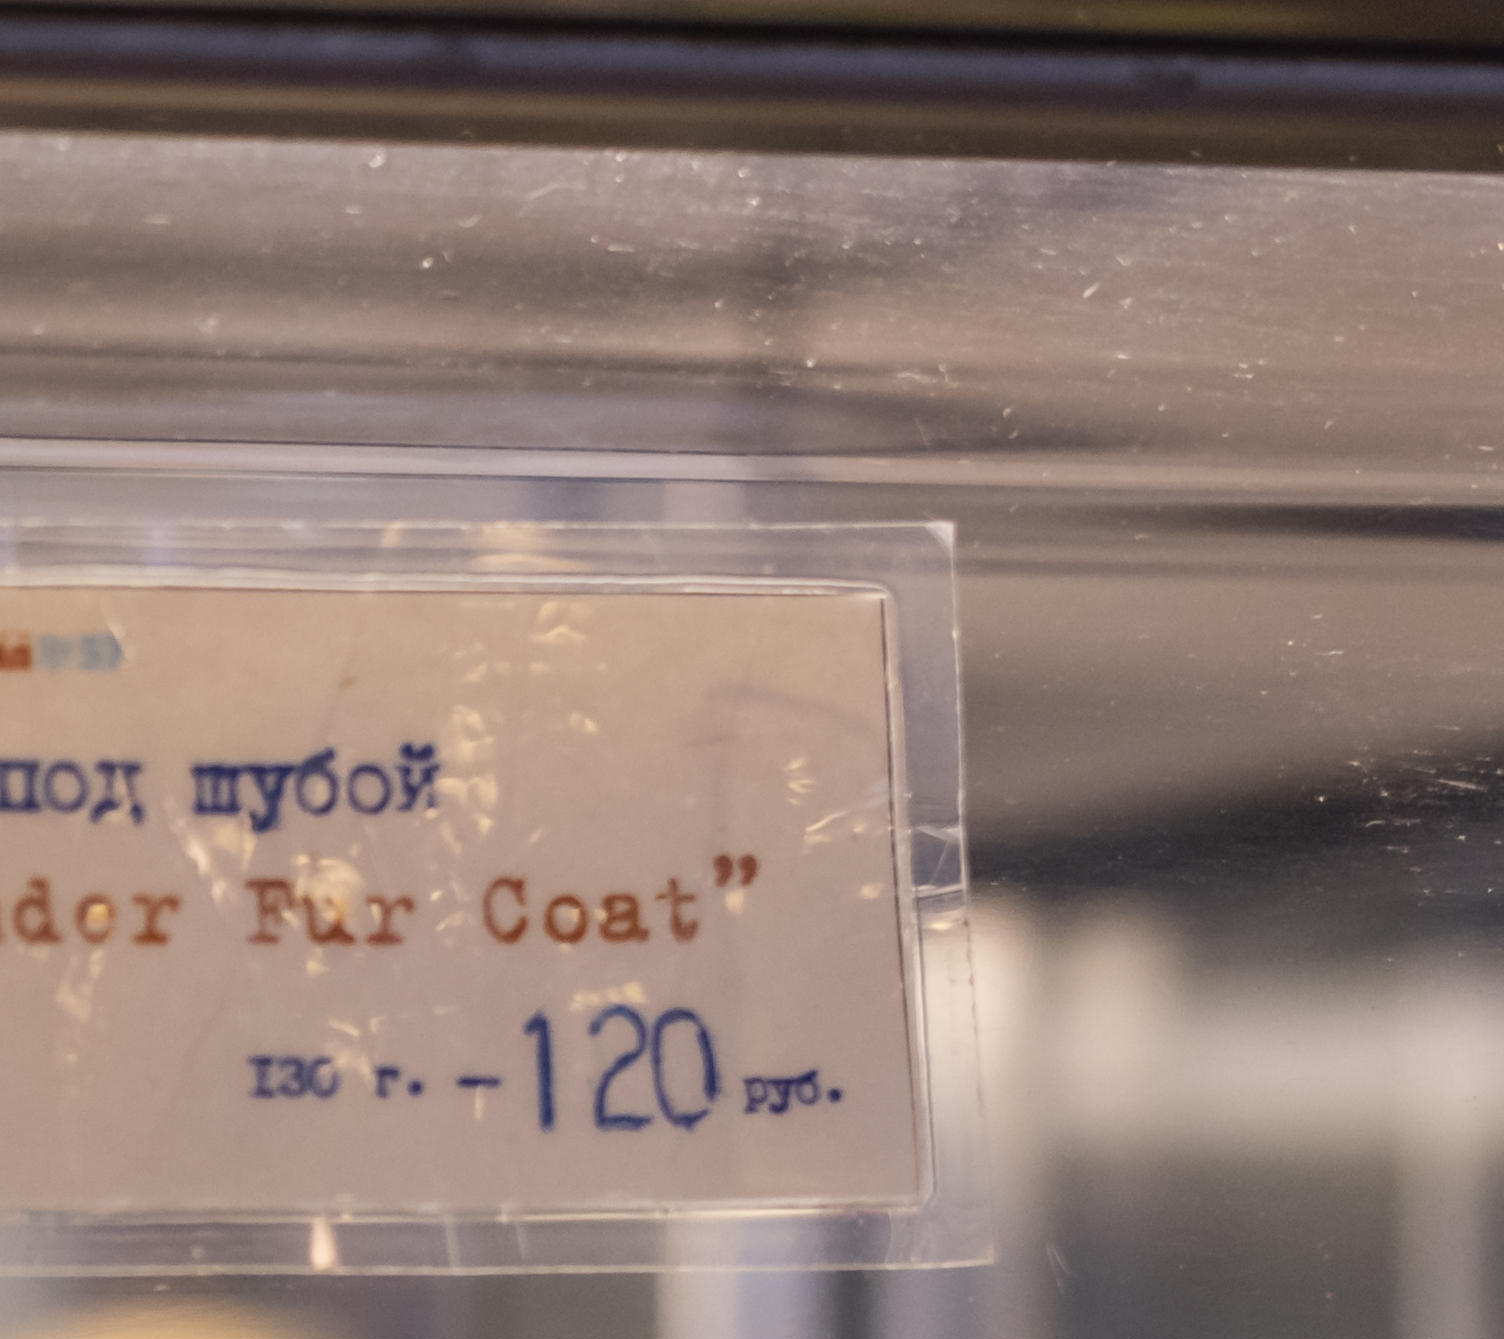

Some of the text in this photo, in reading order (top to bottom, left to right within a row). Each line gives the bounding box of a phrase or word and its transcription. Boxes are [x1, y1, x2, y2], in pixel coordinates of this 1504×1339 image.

[191, 742, 441, 833] шубой
[244, 875, 415, 946] Fur
[742, 1069, 845, 1116] руб.
